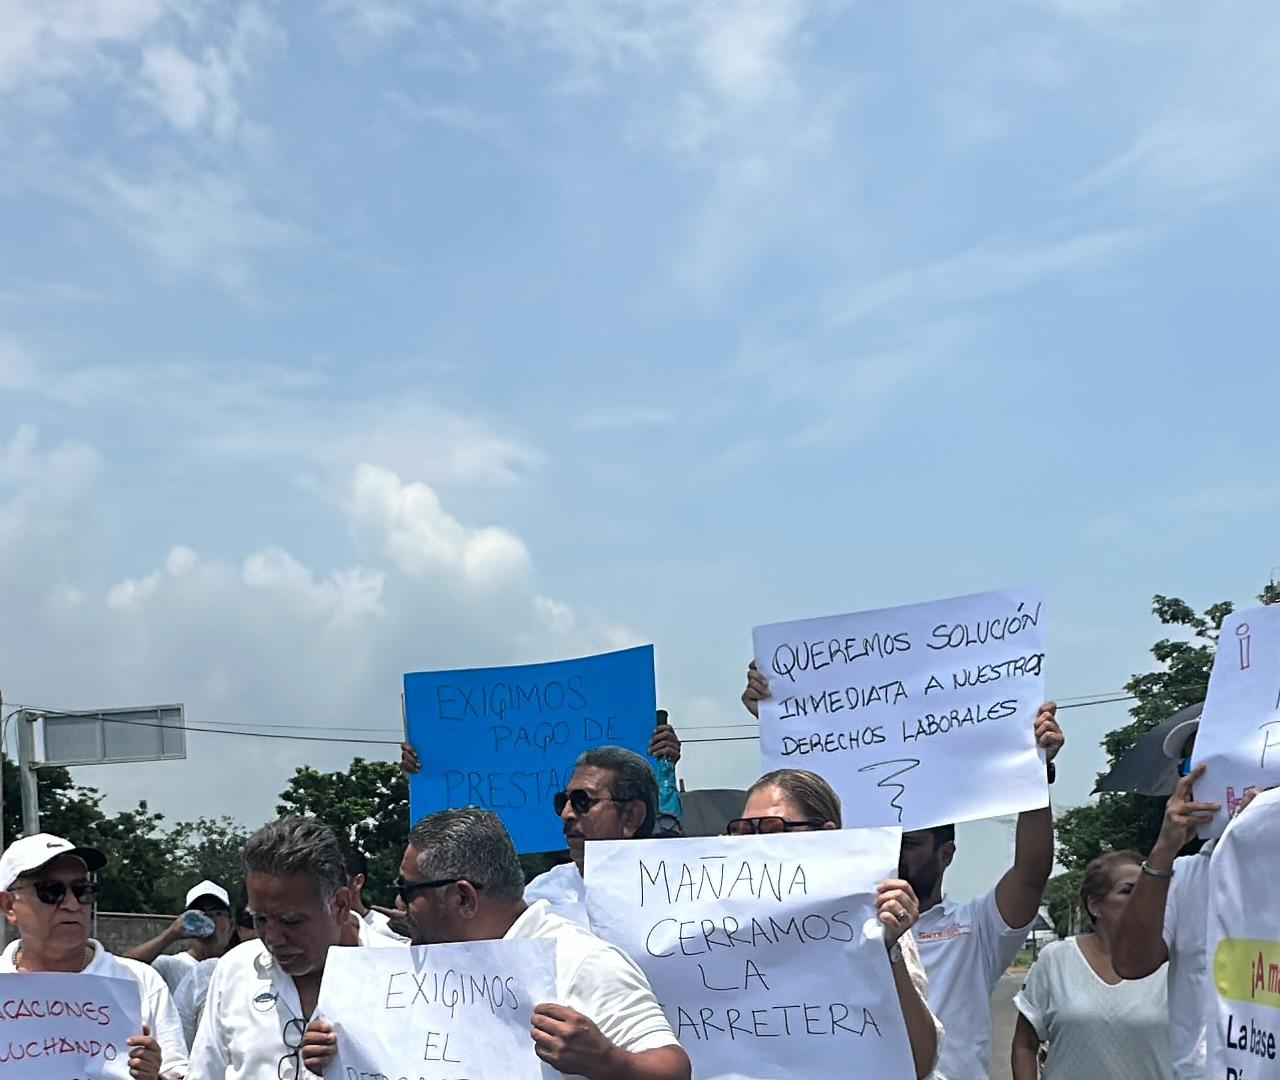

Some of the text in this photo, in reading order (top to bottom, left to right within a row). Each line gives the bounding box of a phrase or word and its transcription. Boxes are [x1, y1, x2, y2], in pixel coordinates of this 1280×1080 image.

[772, 602, 1042, 682] QUEREMOS SOLUCIÓN
[436, 674, 588, 721] EXIGIMOS
[778, 652, 1045, 720] INMEDIATA A NUESTROS
[489, 715, 624, 758] PAGO DE
[781, 699, 1018, 756] DERECHOS LABORALES
[639, 855, 808, 907] MAÑANA
[645, 910, 854, 958] CERRAMOS
[385, 969, 519, 1018] EXIGIMOS
[697, 959, 770, 991] LA
[1251, 951, 1264, 998] ¡A
[658, 1003, 881, 1041] ARRETERA
[1226, 1014, 1247, 1051] La
[1250, 1018, 1275, 1060] base
[423, 1031, 461, 1063] EL
